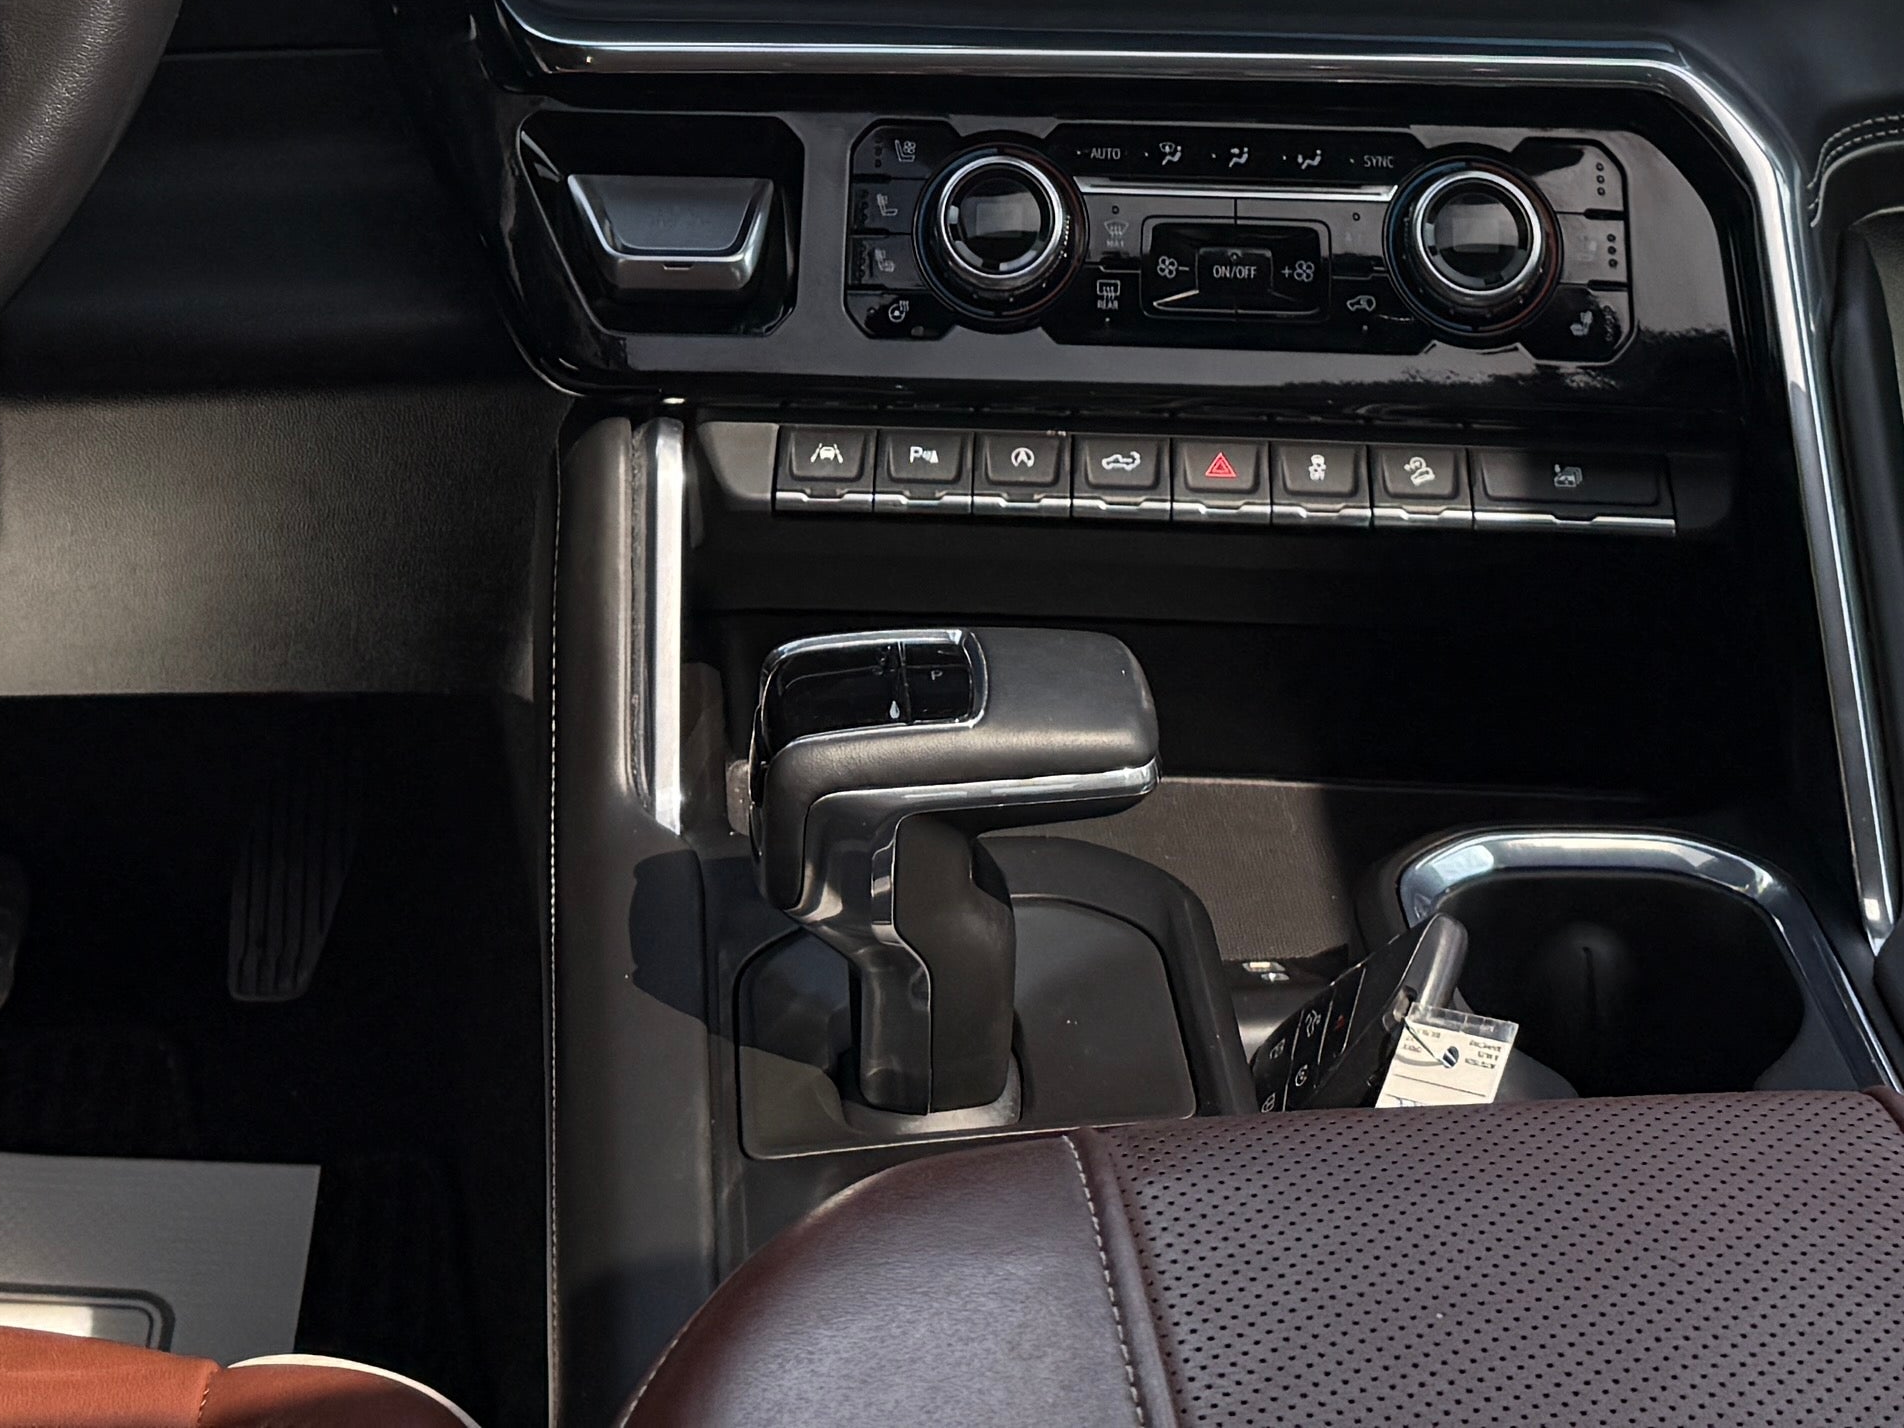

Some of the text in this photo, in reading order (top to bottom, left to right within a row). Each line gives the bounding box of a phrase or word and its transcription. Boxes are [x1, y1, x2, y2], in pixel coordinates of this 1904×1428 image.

[1090, 147, 1122, 161] AUTO
[1363, 155, 1394, 169] SYNC
[1212, 265, 1257, 280] ON/OFF
[1097, 300, 1119, 310] REAR
